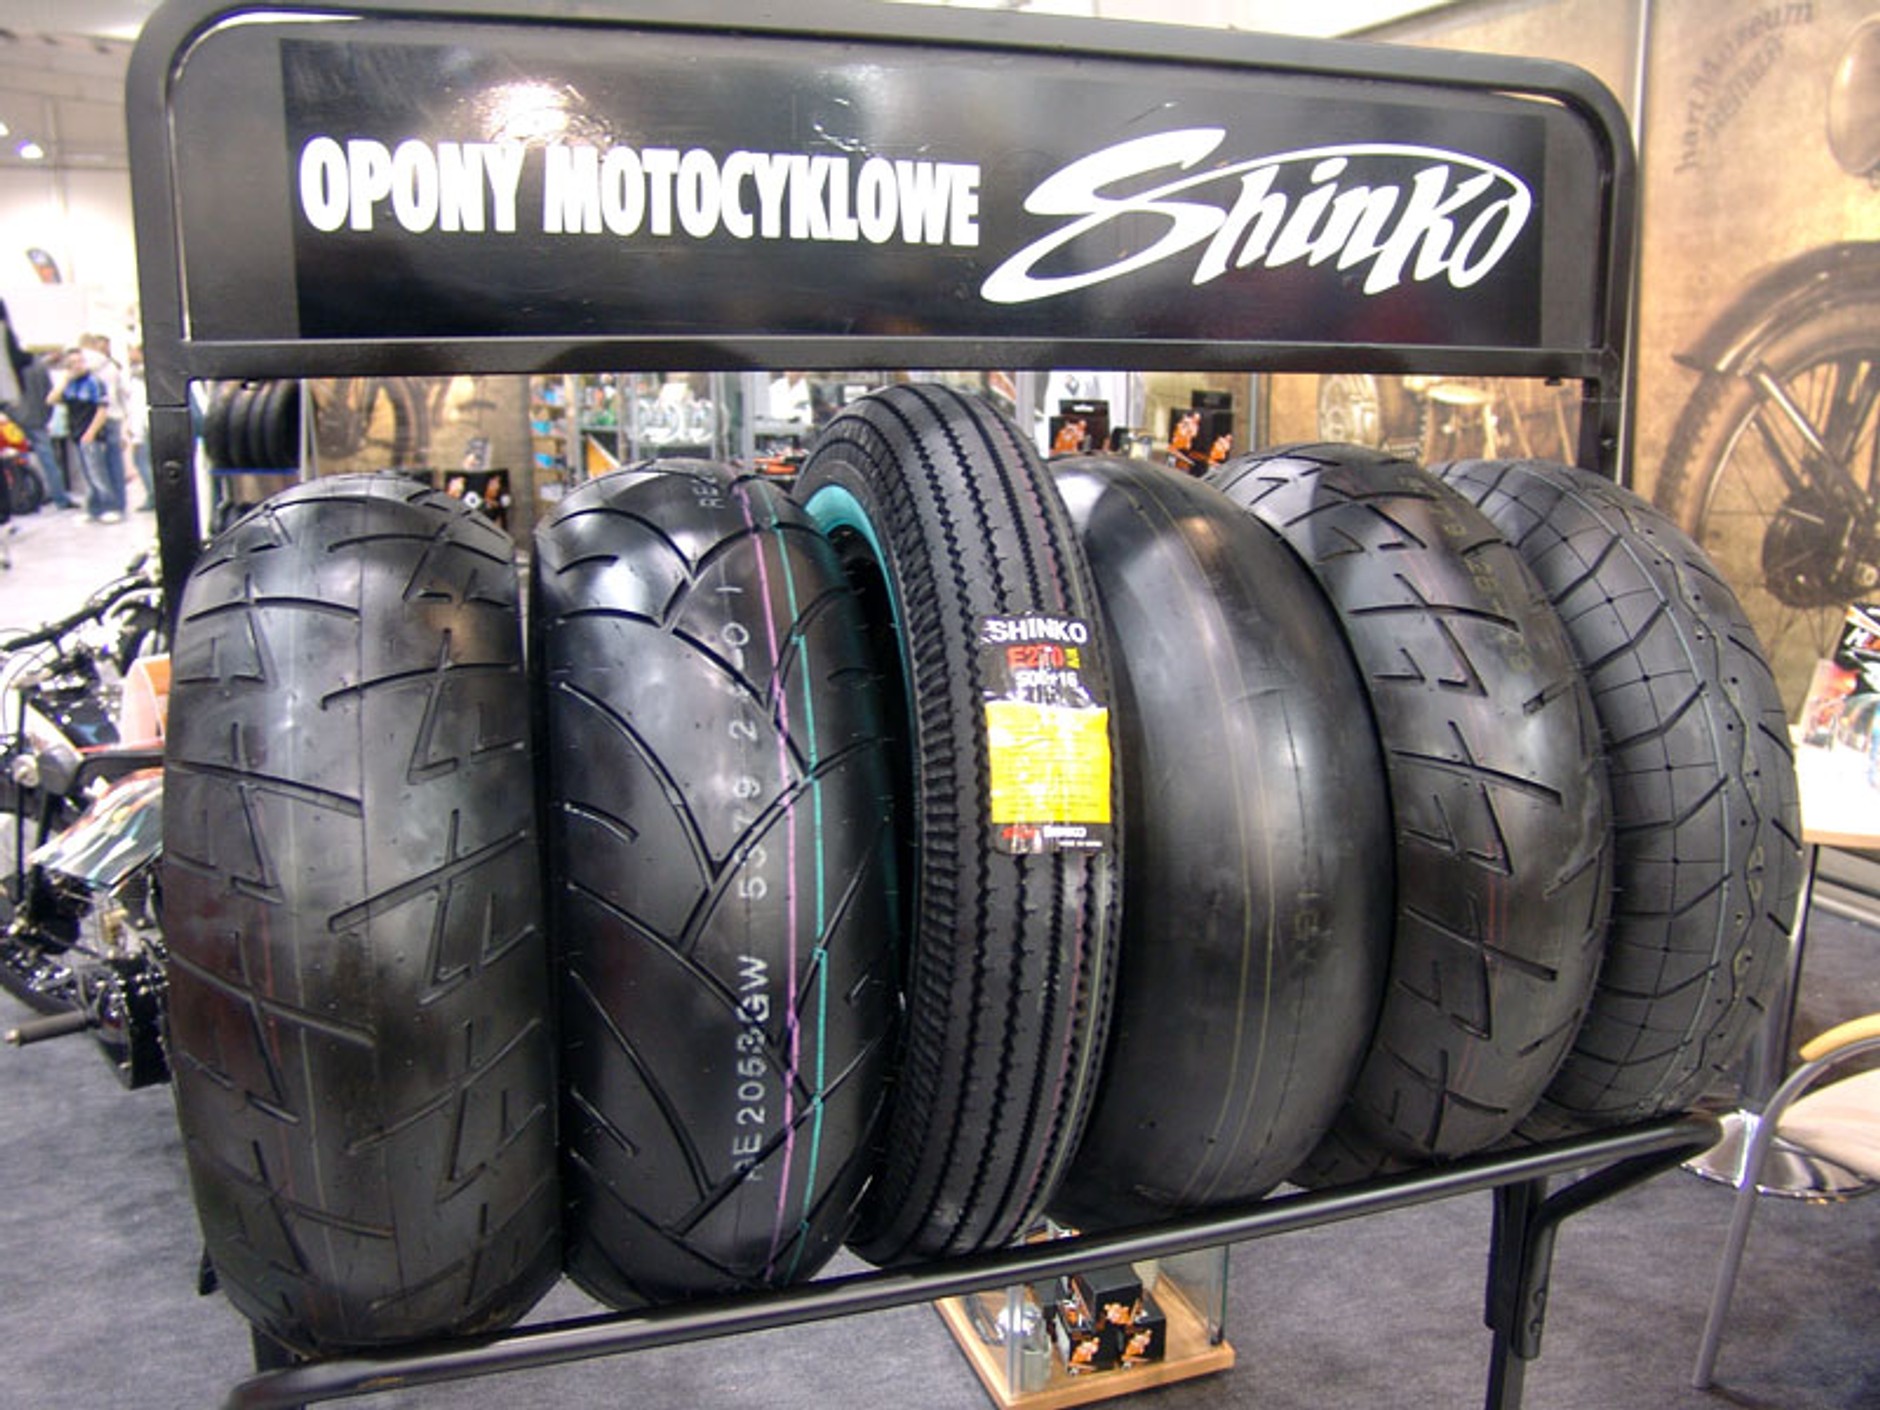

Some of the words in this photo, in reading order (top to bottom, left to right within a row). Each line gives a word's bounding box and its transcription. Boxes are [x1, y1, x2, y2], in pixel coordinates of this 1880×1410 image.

[300, 137, 526, 233] OPONY
[543, 145, 980, 246] MOTOCYKLOWE
[981, 128, 1532, 303] Shinko
[984, 618, 1087, 644] SHINKO
